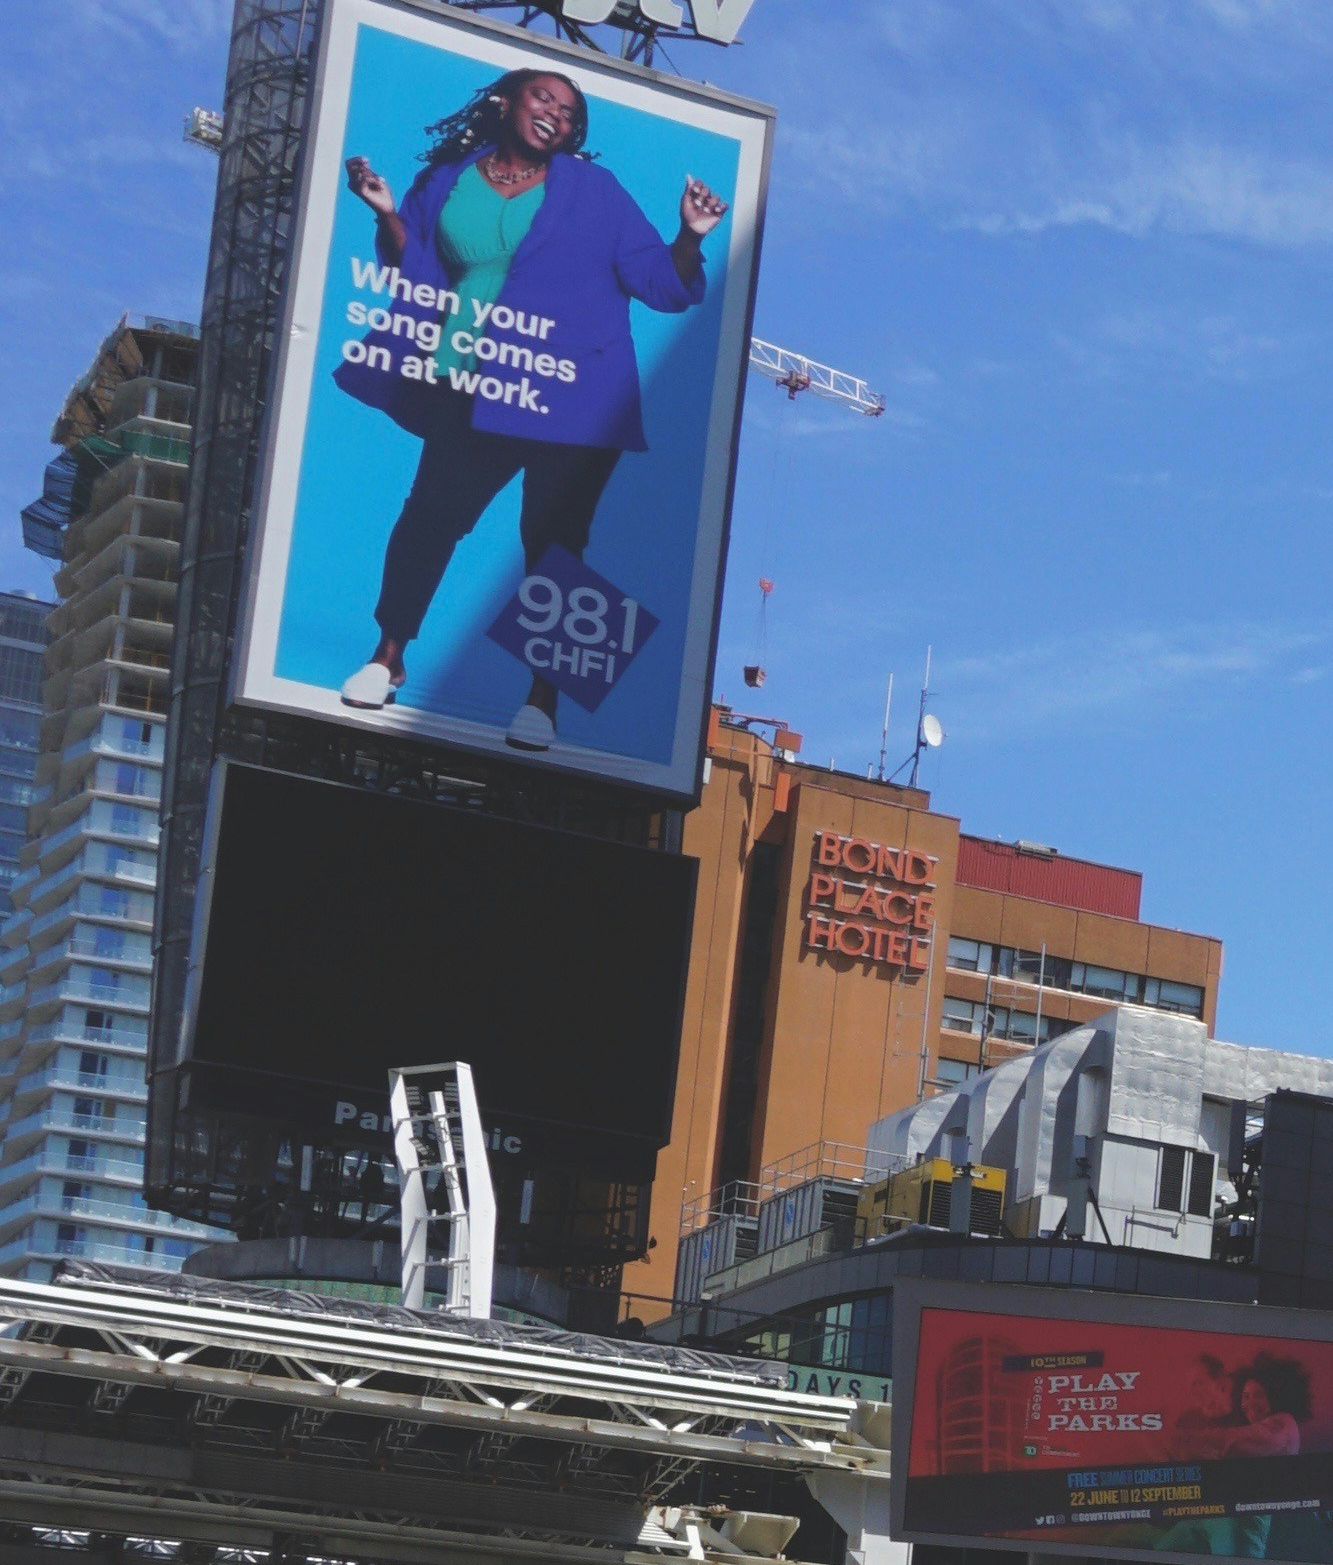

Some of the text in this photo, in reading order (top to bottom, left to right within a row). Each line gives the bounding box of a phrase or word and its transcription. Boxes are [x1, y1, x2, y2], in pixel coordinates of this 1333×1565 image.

[351, 256, 556, 341] When your
[346, 301, 577, 383] song comes
[341, 339, 550, 415] on at work.
[516, 575, 638, 654] 98.1
[524, 636, 616, 684] CHFI
[818, 830, 935, 885] BOND
[809, 873, 936, 930] PLACE
[808, 914, 930, 971] HOTEL
[1048, 1372, 1140, 1394] PLAY
[1057, 1396, 1118, 1412] THE
[1048, 1414, 1164, 1432] PARKS
[1067, 1472, 1098, 1488] FREE
[1134, 1467, 1174, 1485] CONCERT
[1070, 1491, 1086, 1507] 22
[1087, 1489, 1119, 1505] JUNE
[1131, 1488, 1141, 1503] 12
[1142, 1485, 1201, 1502] SEPTEMBER
